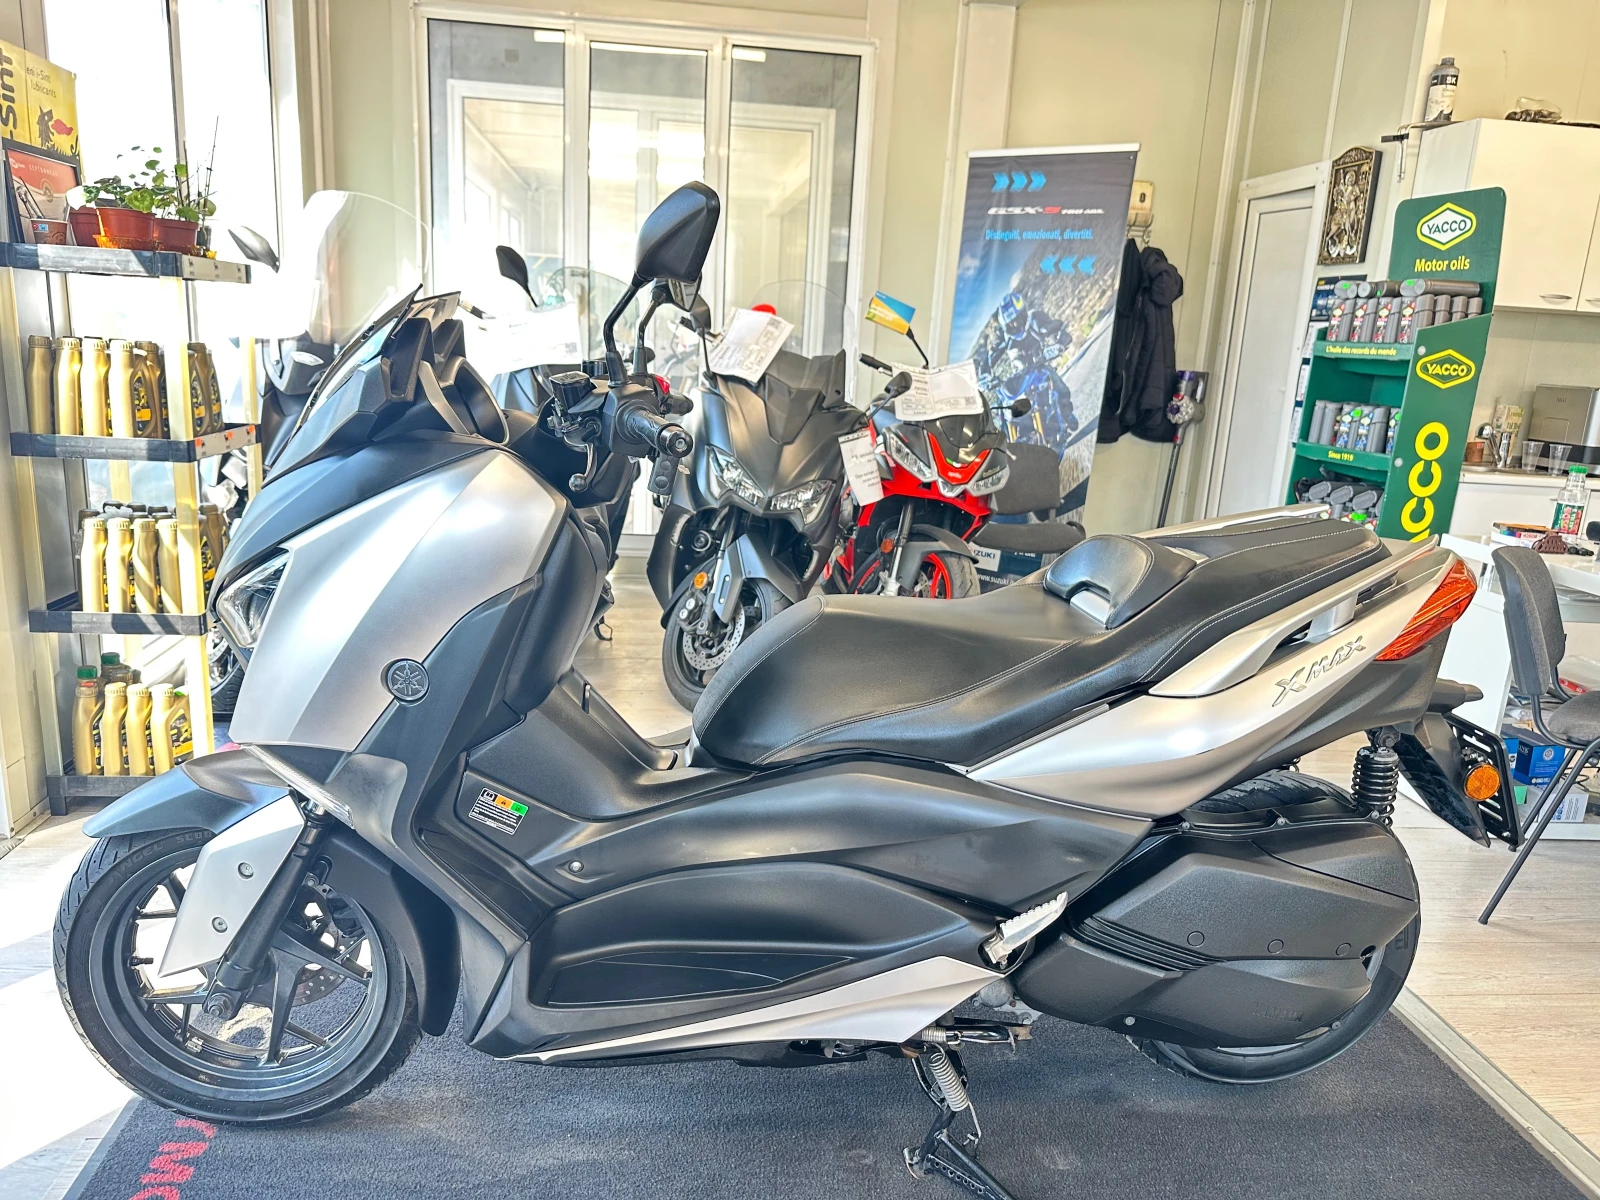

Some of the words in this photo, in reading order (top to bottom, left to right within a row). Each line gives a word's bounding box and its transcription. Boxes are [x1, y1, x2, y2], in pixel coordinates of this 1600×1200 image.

[0, 47, 17, 139] -Sint
[30, 79, 57, 98] lubricants
[1426, 219, 1467, 235] YACCO
[985, 229, 1020, 241] Distinguiti,
[1022, 229, 1061, 241] emozionati,
[1063, 228, 1093, 240] divertiti.
[1414, 258, 1448, 272] Motor
[1449, 255, 1470, 270] oils
[1378, 347, 1397, 356] monde
[1426, 363, 1468, 377] YACCO
[1328, 450, 1341, 460] Since
[1341, 452, 1354, 462] 1919
[1400, 421, 1449, 542] CCO
[973, 549, 996, 560] ZUKI
[176, 830, 213, 844] SCOO
